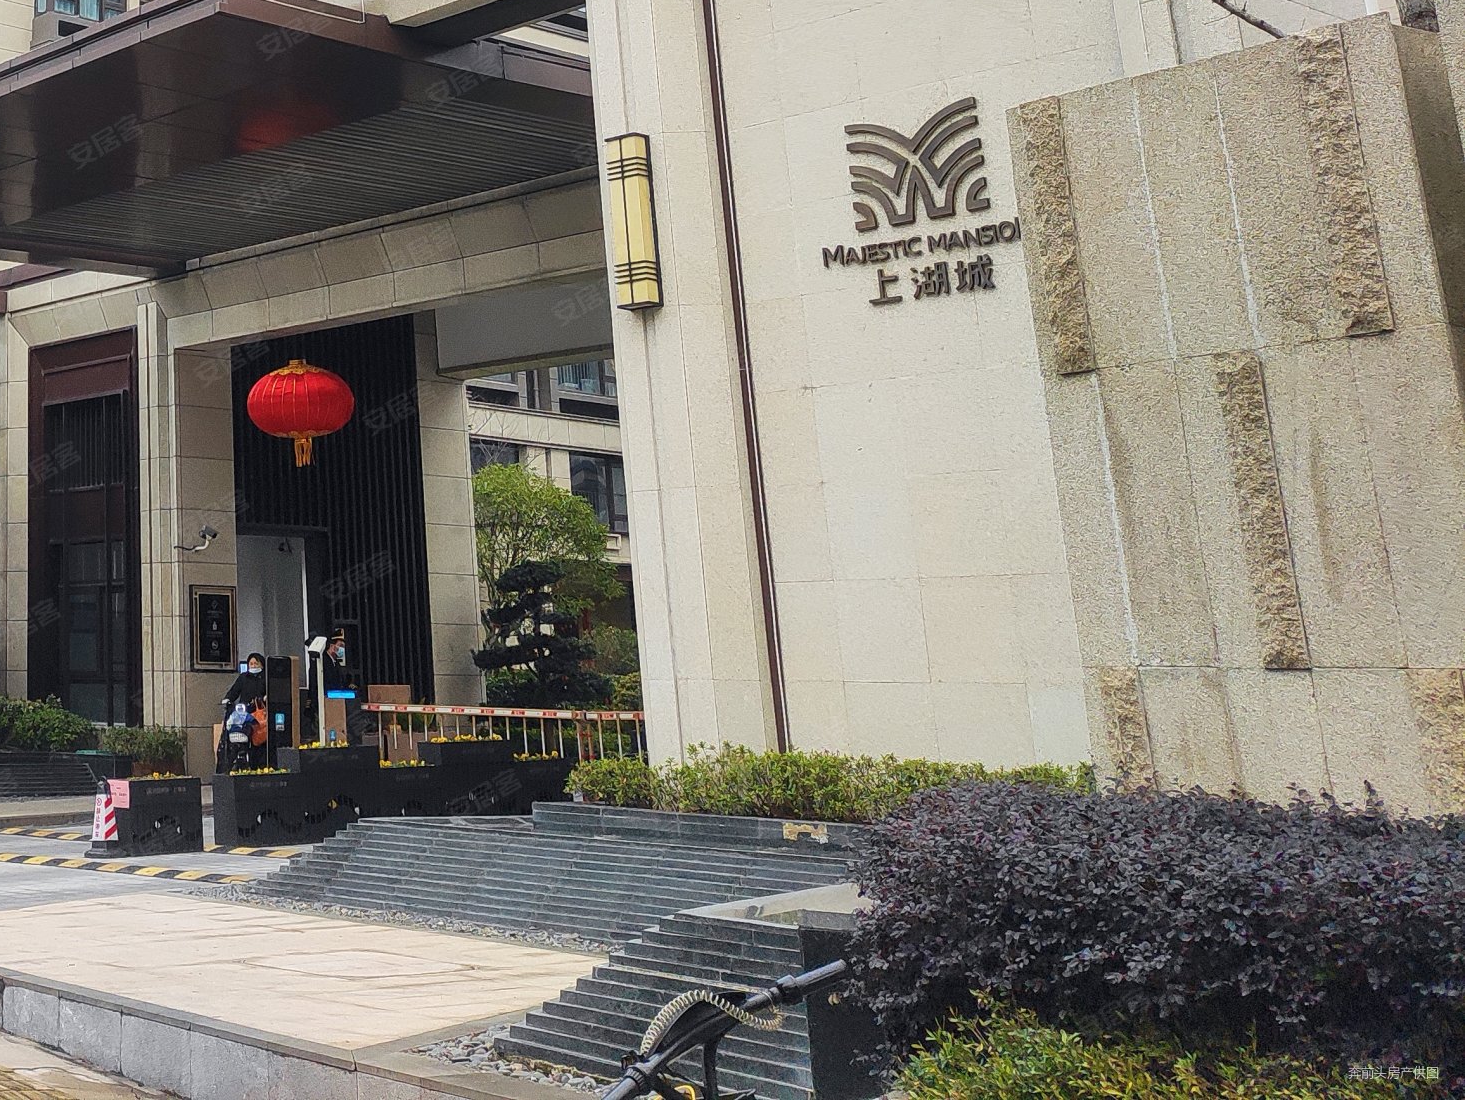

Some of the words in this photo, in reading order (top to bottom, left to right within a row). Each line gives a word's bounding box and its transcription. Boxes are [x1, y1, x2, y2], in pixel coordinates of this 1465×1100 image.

[822, 236, 923, 268] MAJESTIC
[927, 217, 1021, 254] MANSIO
[869, 254, 996, 305] 上湖城
